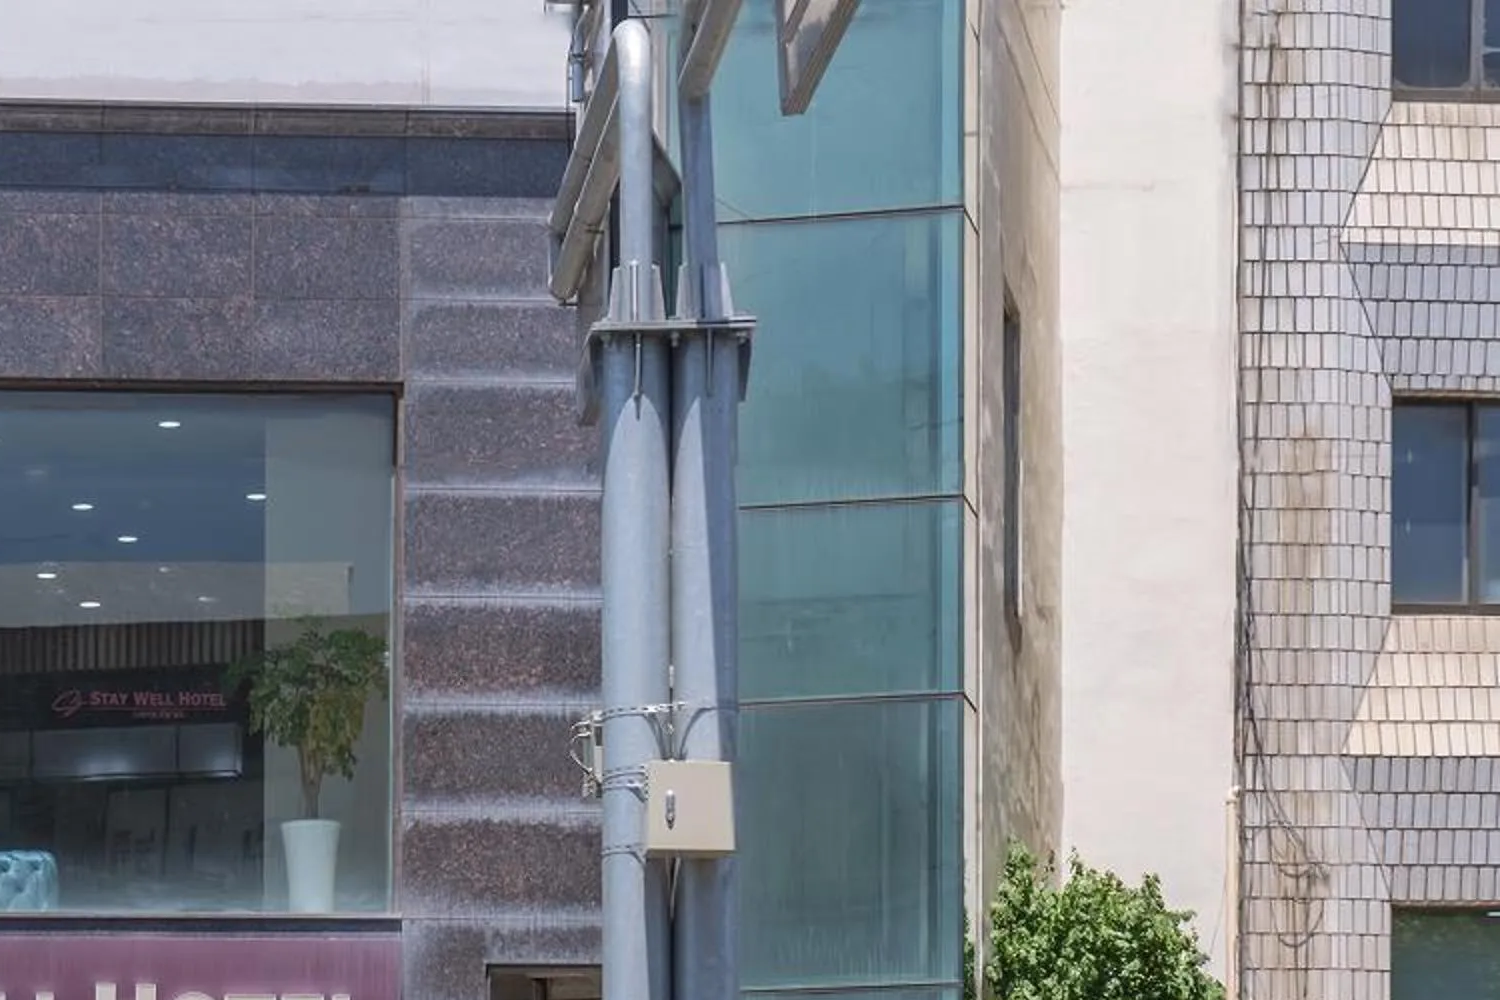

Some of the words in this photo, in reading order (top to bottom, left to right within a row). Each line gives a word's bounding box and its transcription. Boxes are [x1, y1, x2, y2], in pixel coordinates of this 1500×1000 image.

[89, 691, 128, 706] STAY
[133, 691, 174, 706] WELL
[179, 691, 227, 707] HOTEL
